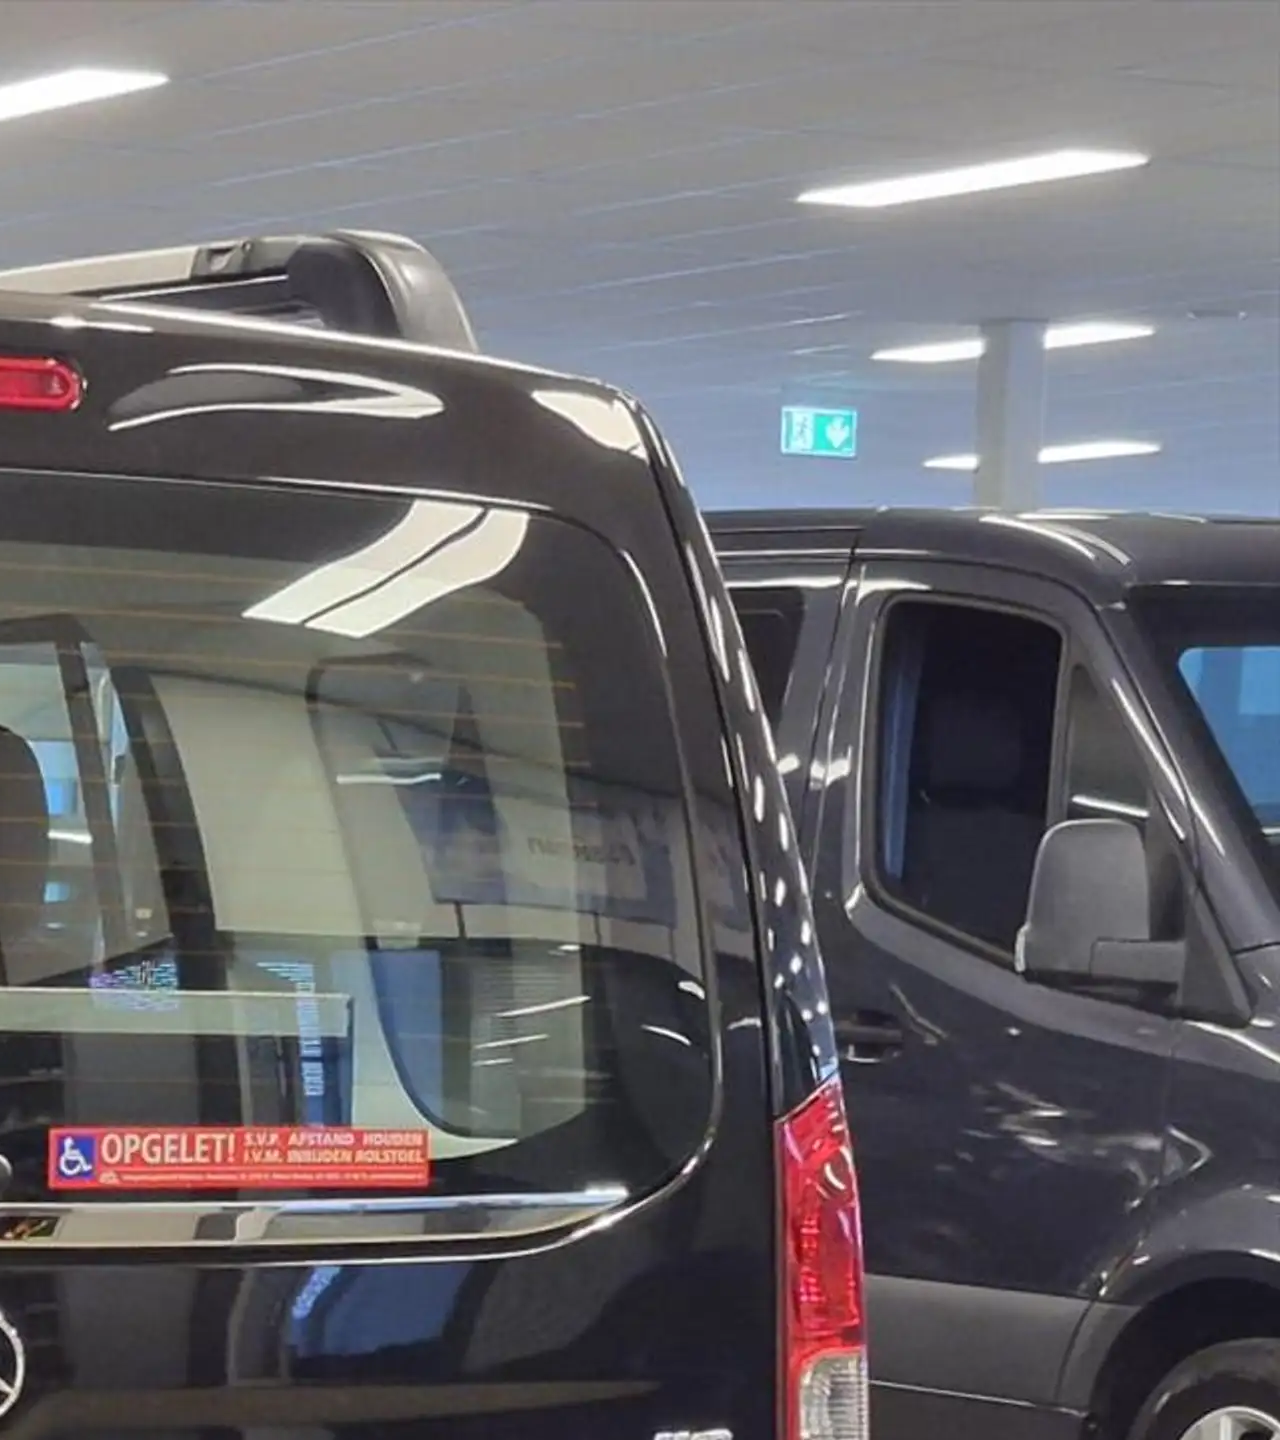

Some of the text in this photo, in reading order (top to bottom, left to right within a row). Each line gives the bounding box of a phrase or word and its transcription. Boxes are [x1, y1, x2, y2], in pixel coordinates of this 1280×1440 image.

[100, 1132, 236, 1164] OPGELET!
[287, 1132, 356, 1147] AFSTAND
[362, 1132, 424, 1147] HOUDEN
